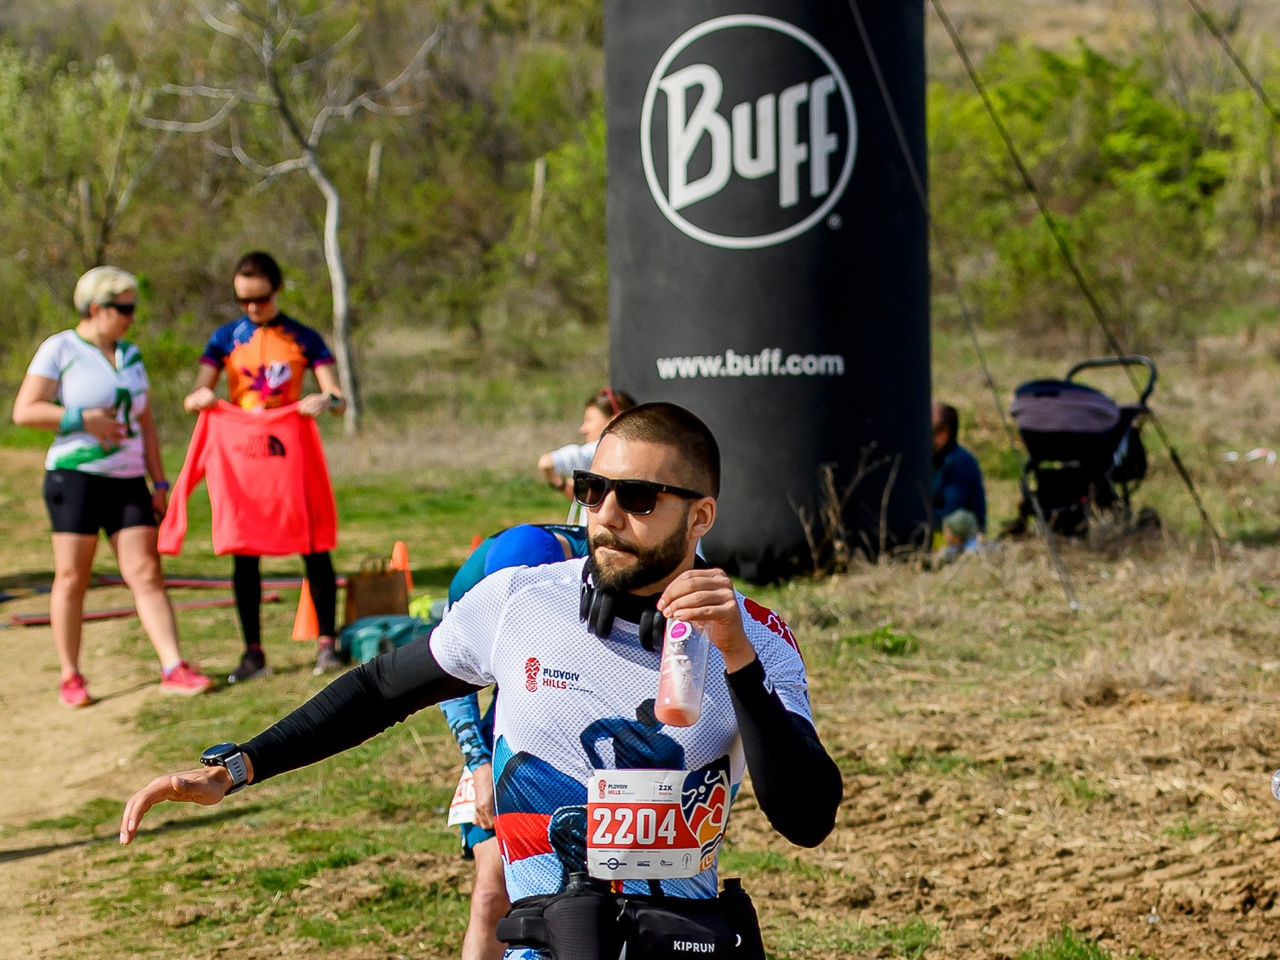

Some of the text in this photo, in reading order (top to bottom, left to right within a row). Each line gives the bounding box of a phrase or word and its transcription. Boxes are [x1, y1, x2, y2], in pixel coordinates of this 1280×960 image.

[657, 348, 844, 380] www.buff.com
[542, 667, 580, 682] PLOVDIV
[542, 678, 567, 690] HILLS
[658, 784, 673, 792] 22K
[592, 807, 677, 846] 2204
[673, 940, 715, 953] KIPRUN
